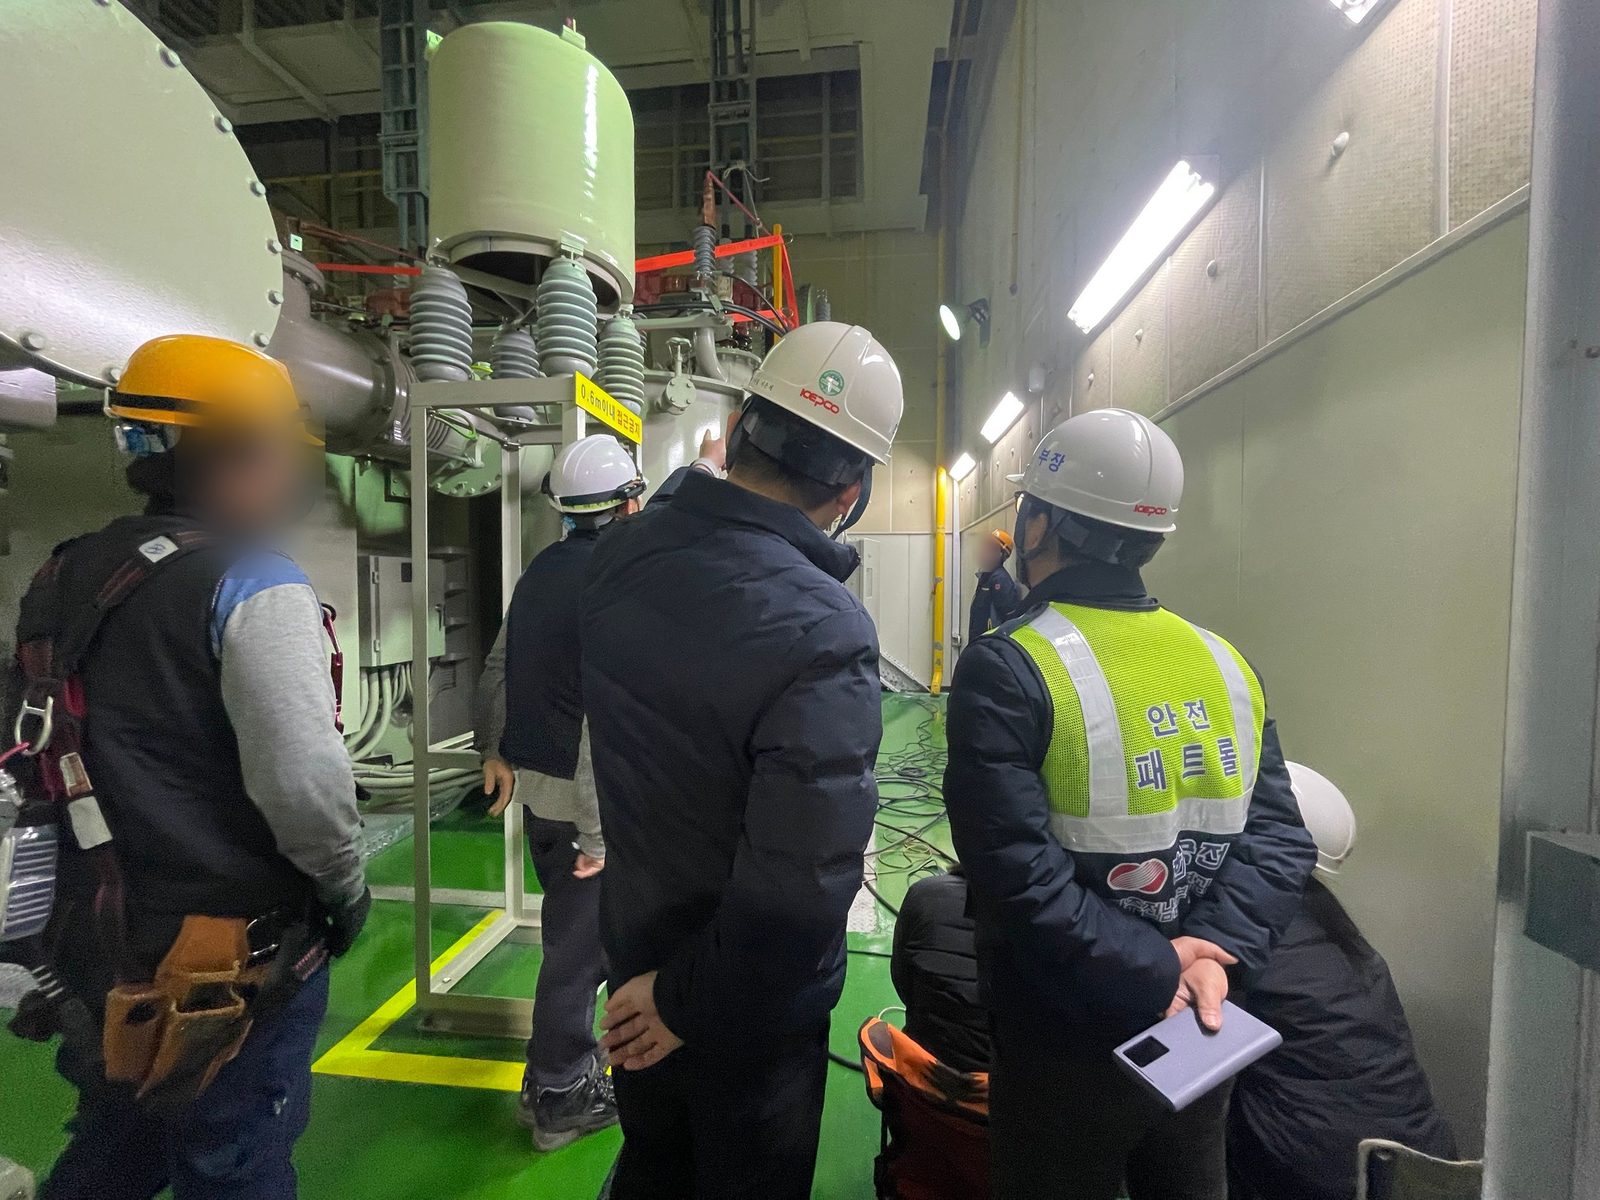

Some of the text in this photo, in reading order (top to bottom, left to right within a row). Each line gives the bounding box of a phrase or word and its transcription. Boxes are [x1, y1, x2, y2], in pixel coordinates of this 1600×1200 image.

[581, 383, 641, 438] 0.6m이내 접근금지
[800, 388, 840, 414] KEPCO
[1038, 449, 1067, 472] 부장
[1133, 504, 1168, 517] KEPCO
[1146, 698, 1211, 738] 안전
[1134, 737, 1238, 791] 패트롤
